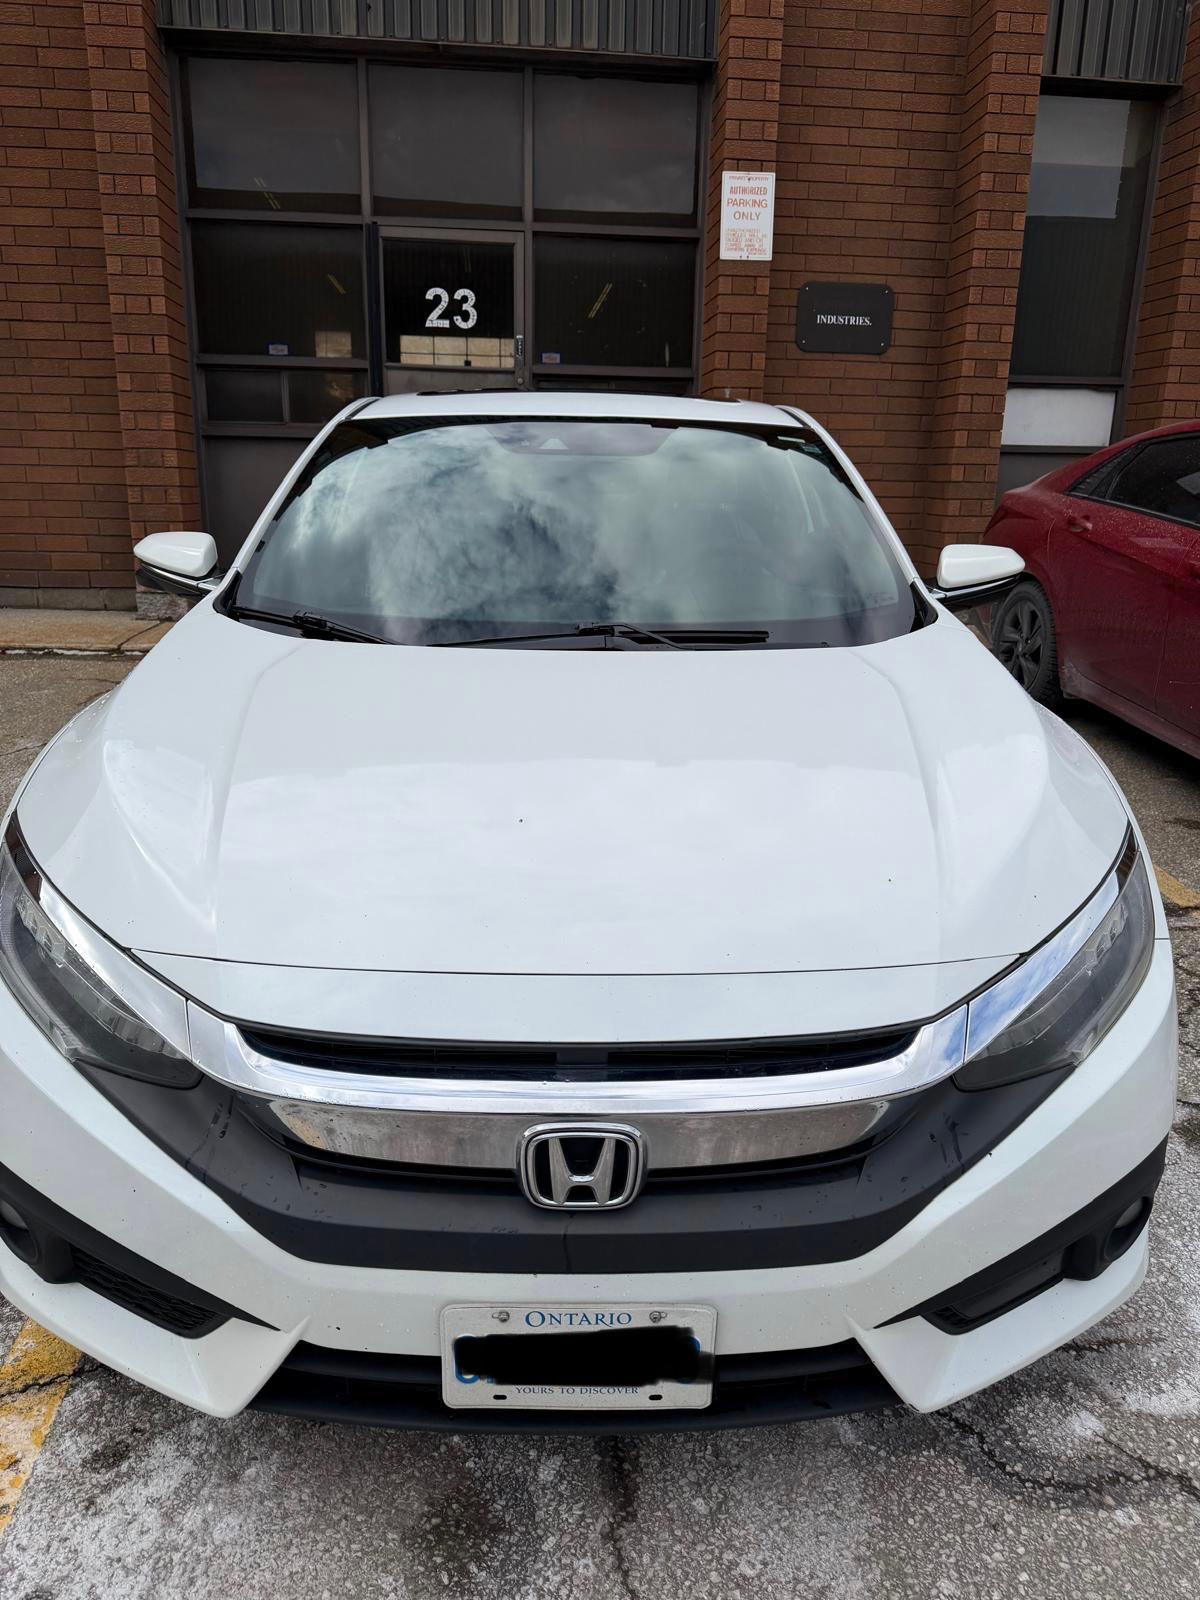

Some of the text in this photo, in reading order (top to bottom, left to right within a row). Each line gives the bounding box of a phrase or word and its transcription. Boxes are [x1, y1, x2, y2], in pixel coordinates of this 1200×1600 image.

[729, 185, 768, 196] AUTHORIZED
[727, 198, 768, 209] PARKING
[733, 210, 761, 221] ONLY
[425, 287, 478, 329] 23
[816, 314, 872, 326] INDUSTRIES.
[525, 1310, 632, 1328] ONTARIO
[514, 1386, 639, 1395] YOURS TO DISCOVER
